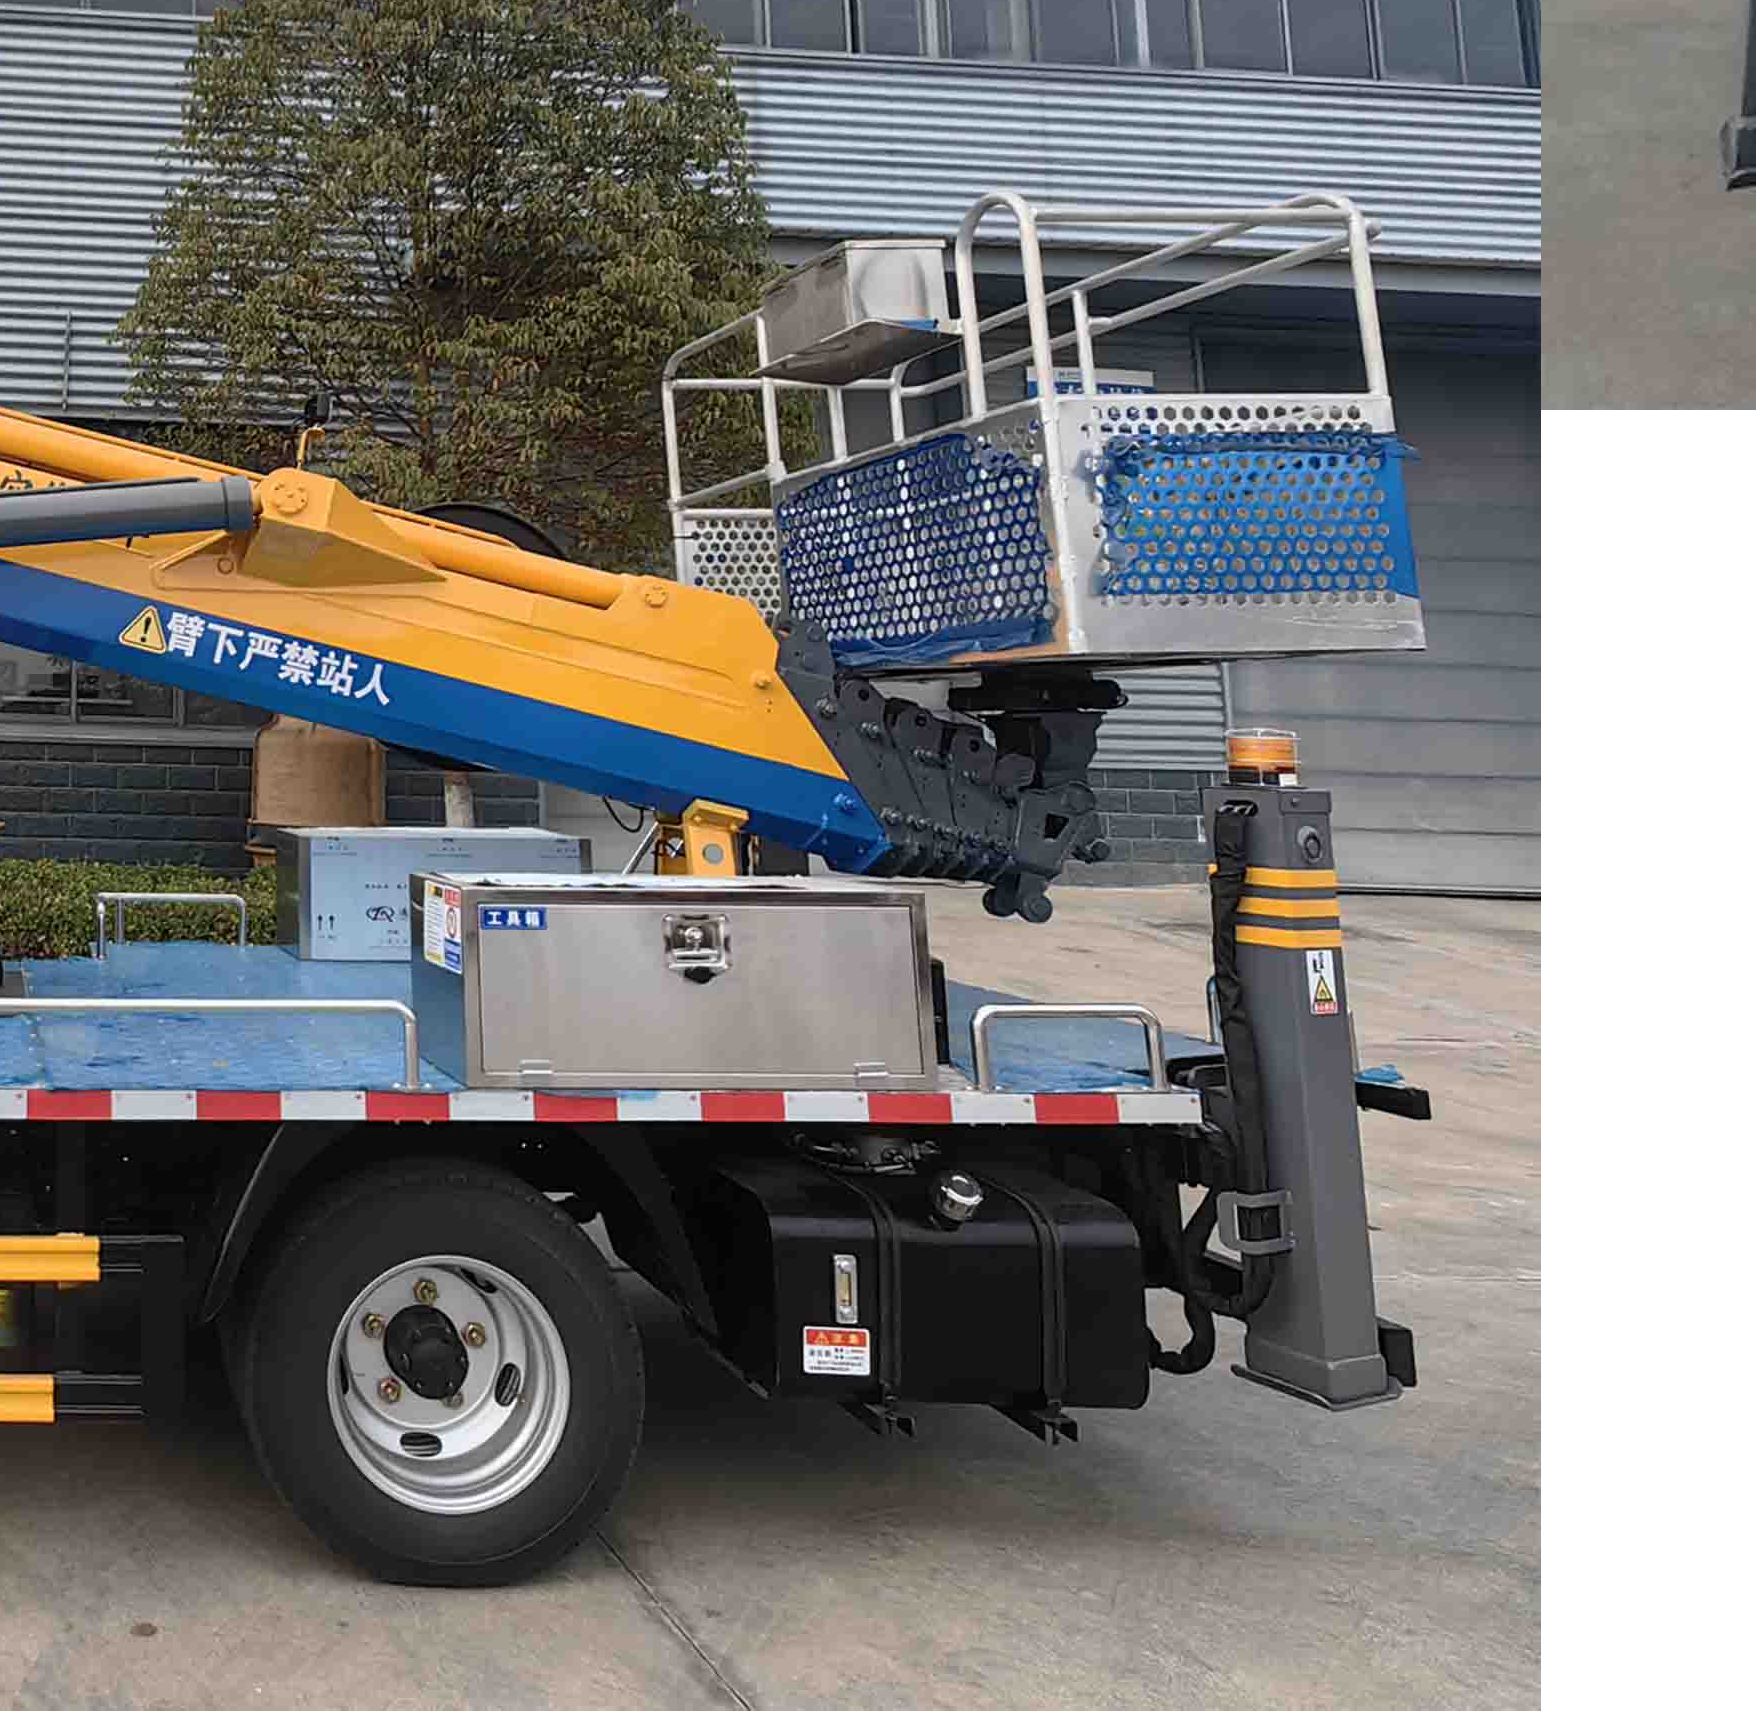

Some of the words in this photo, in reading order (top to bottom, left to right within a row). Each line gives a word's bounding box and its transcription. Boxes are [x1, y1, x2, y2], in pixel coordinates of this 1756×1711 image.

[167, 611, 390, 706] 臂下严禁站人
[487, 911, 541, 928] 工具箱
